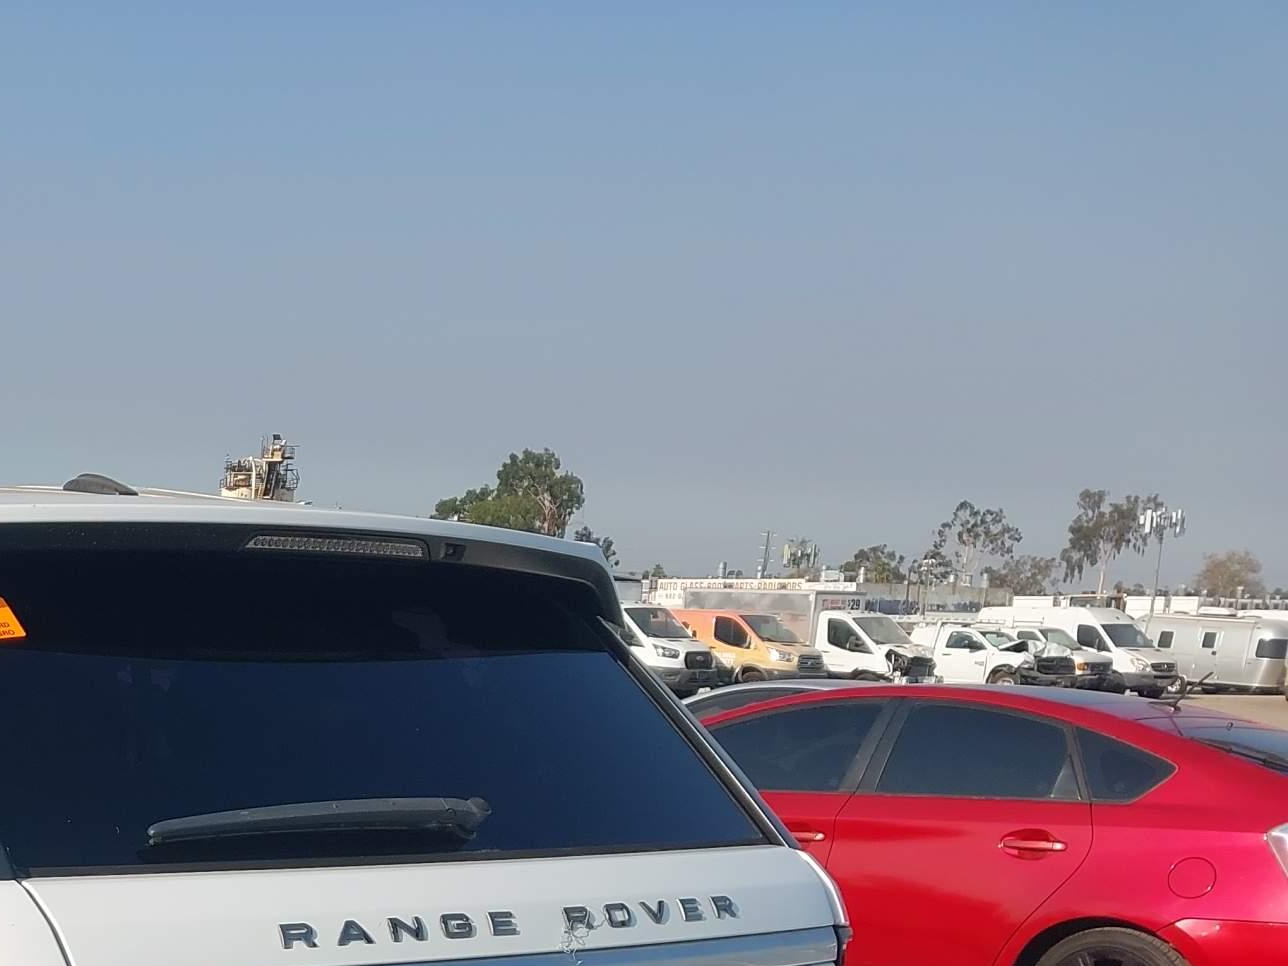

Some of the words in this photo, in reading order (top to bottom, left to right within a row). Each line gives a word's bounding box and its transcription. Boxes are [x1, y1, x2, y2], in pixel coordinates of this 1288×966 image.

[659, 581, 678, 591] AUTO
[279, 910, 522, 950] RANGE
[562, 895, 742, 930] ROVER
